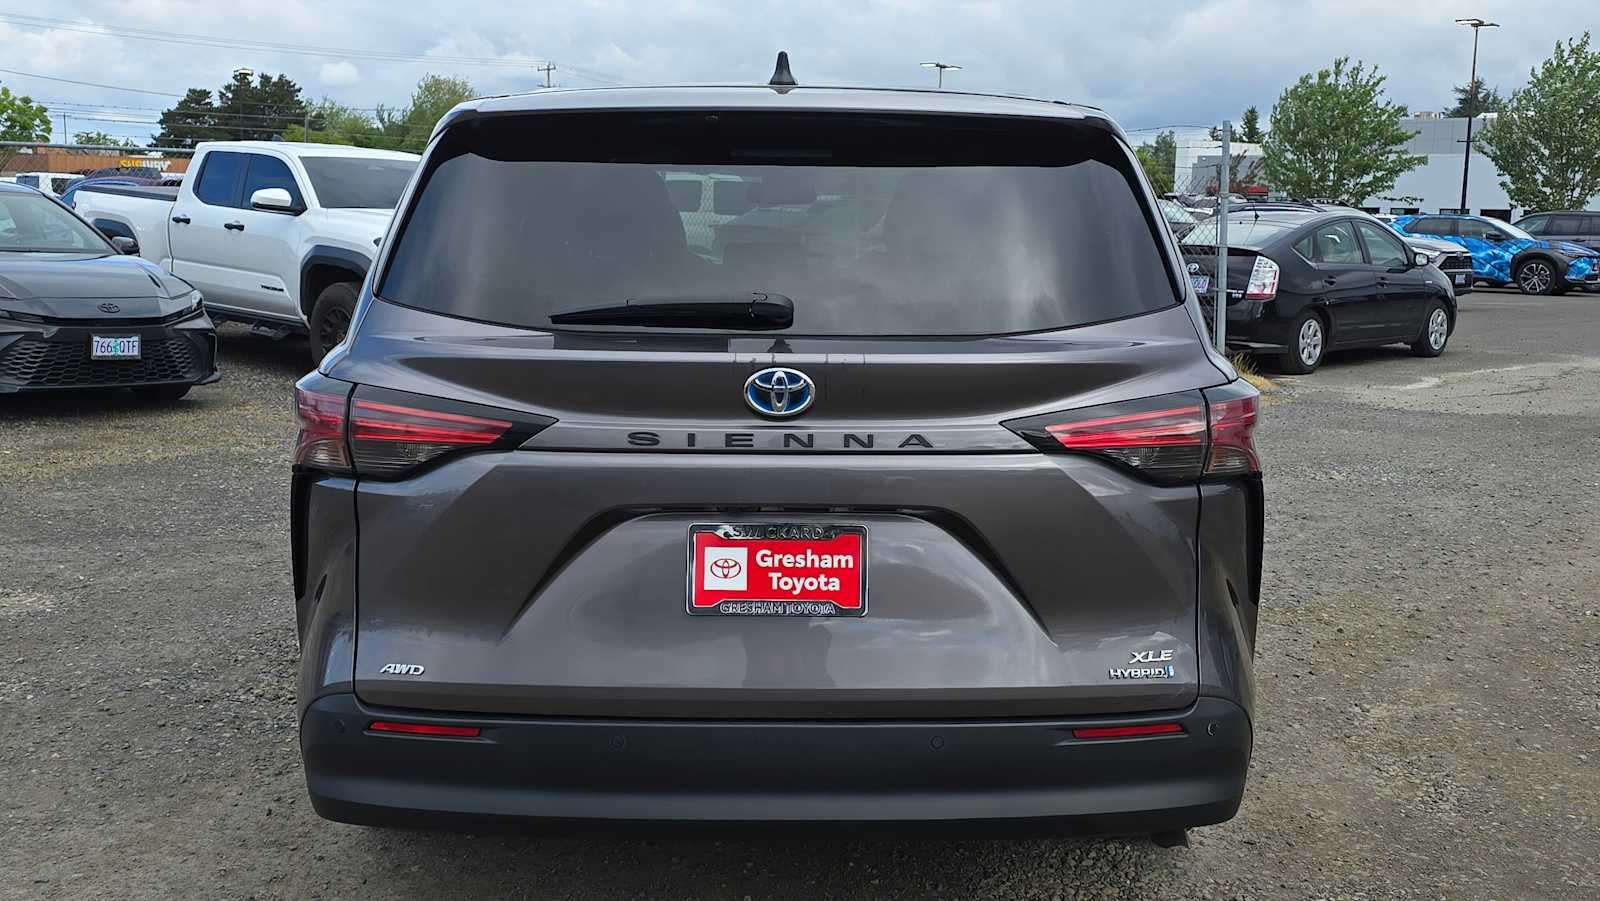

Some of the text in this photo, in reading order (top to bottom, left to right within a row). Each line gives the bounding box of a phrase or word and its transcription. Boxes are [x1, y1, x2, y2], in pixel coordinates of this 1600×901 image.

[95, 340, 112, 354] 766
[627, 431, 934, 448] SIENNA
[755, 549, 853, 568] Gresham
[768, 572, 840, 595] Toyota
[720, 601, 836, 615] GRESHAM TOYOTA
[1129, 649, 1174, 664] XLE
[379, 663, 425, 676] AWD
[1108, 668, 1165, 679] HYBRID
